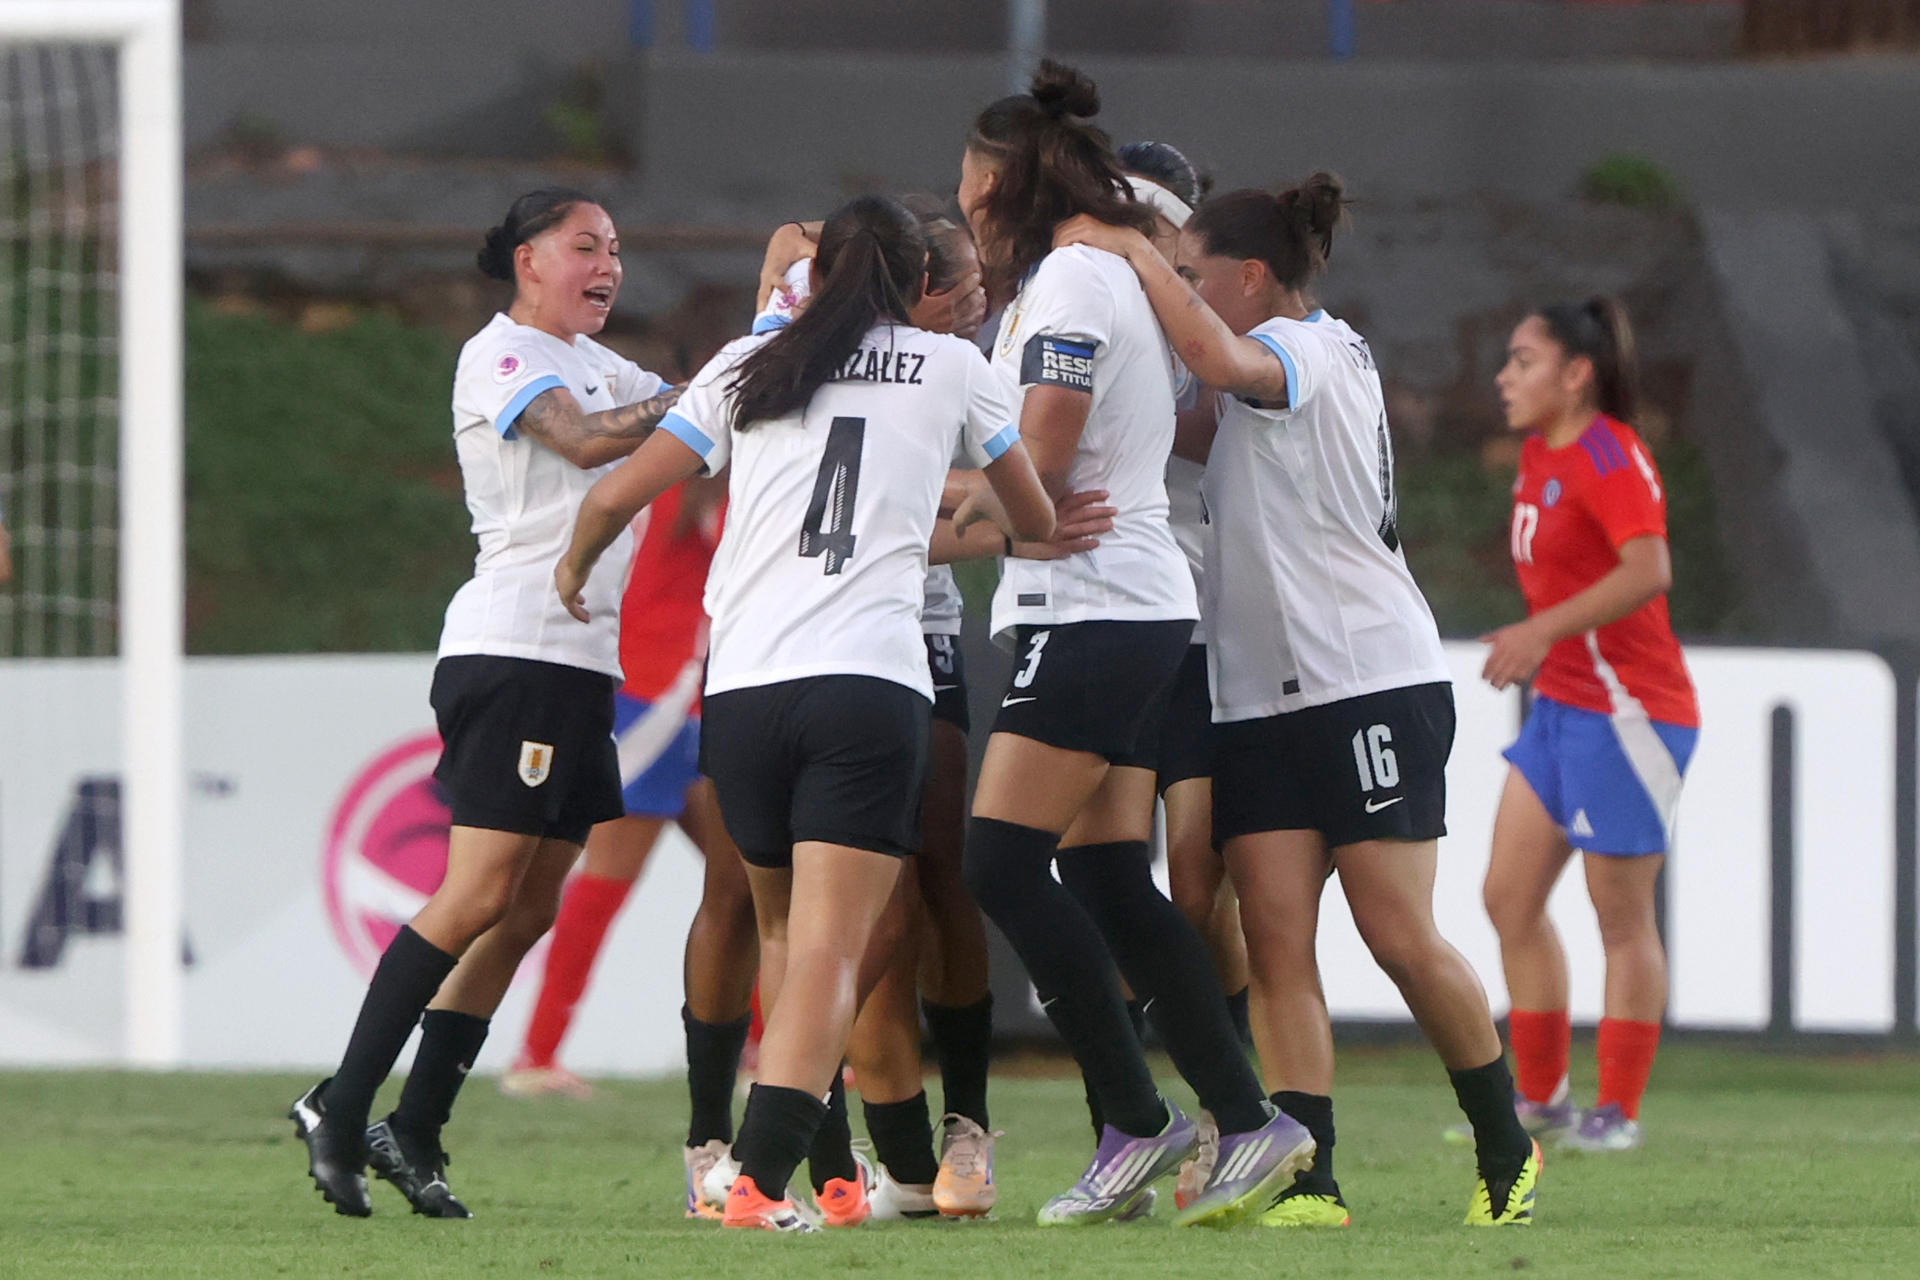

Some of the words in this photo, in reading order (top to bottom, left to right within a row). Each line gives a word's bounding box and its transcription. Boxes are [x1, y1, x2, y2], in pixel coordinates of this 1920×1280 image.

[1042, 340, 1056, 351] EL
[1042, 368, 1059, 380] ES
[798, 416, 866, 576] 4
[1013, 630, 1051, 688] 3
[1351, 723, 1401, 792] 16
